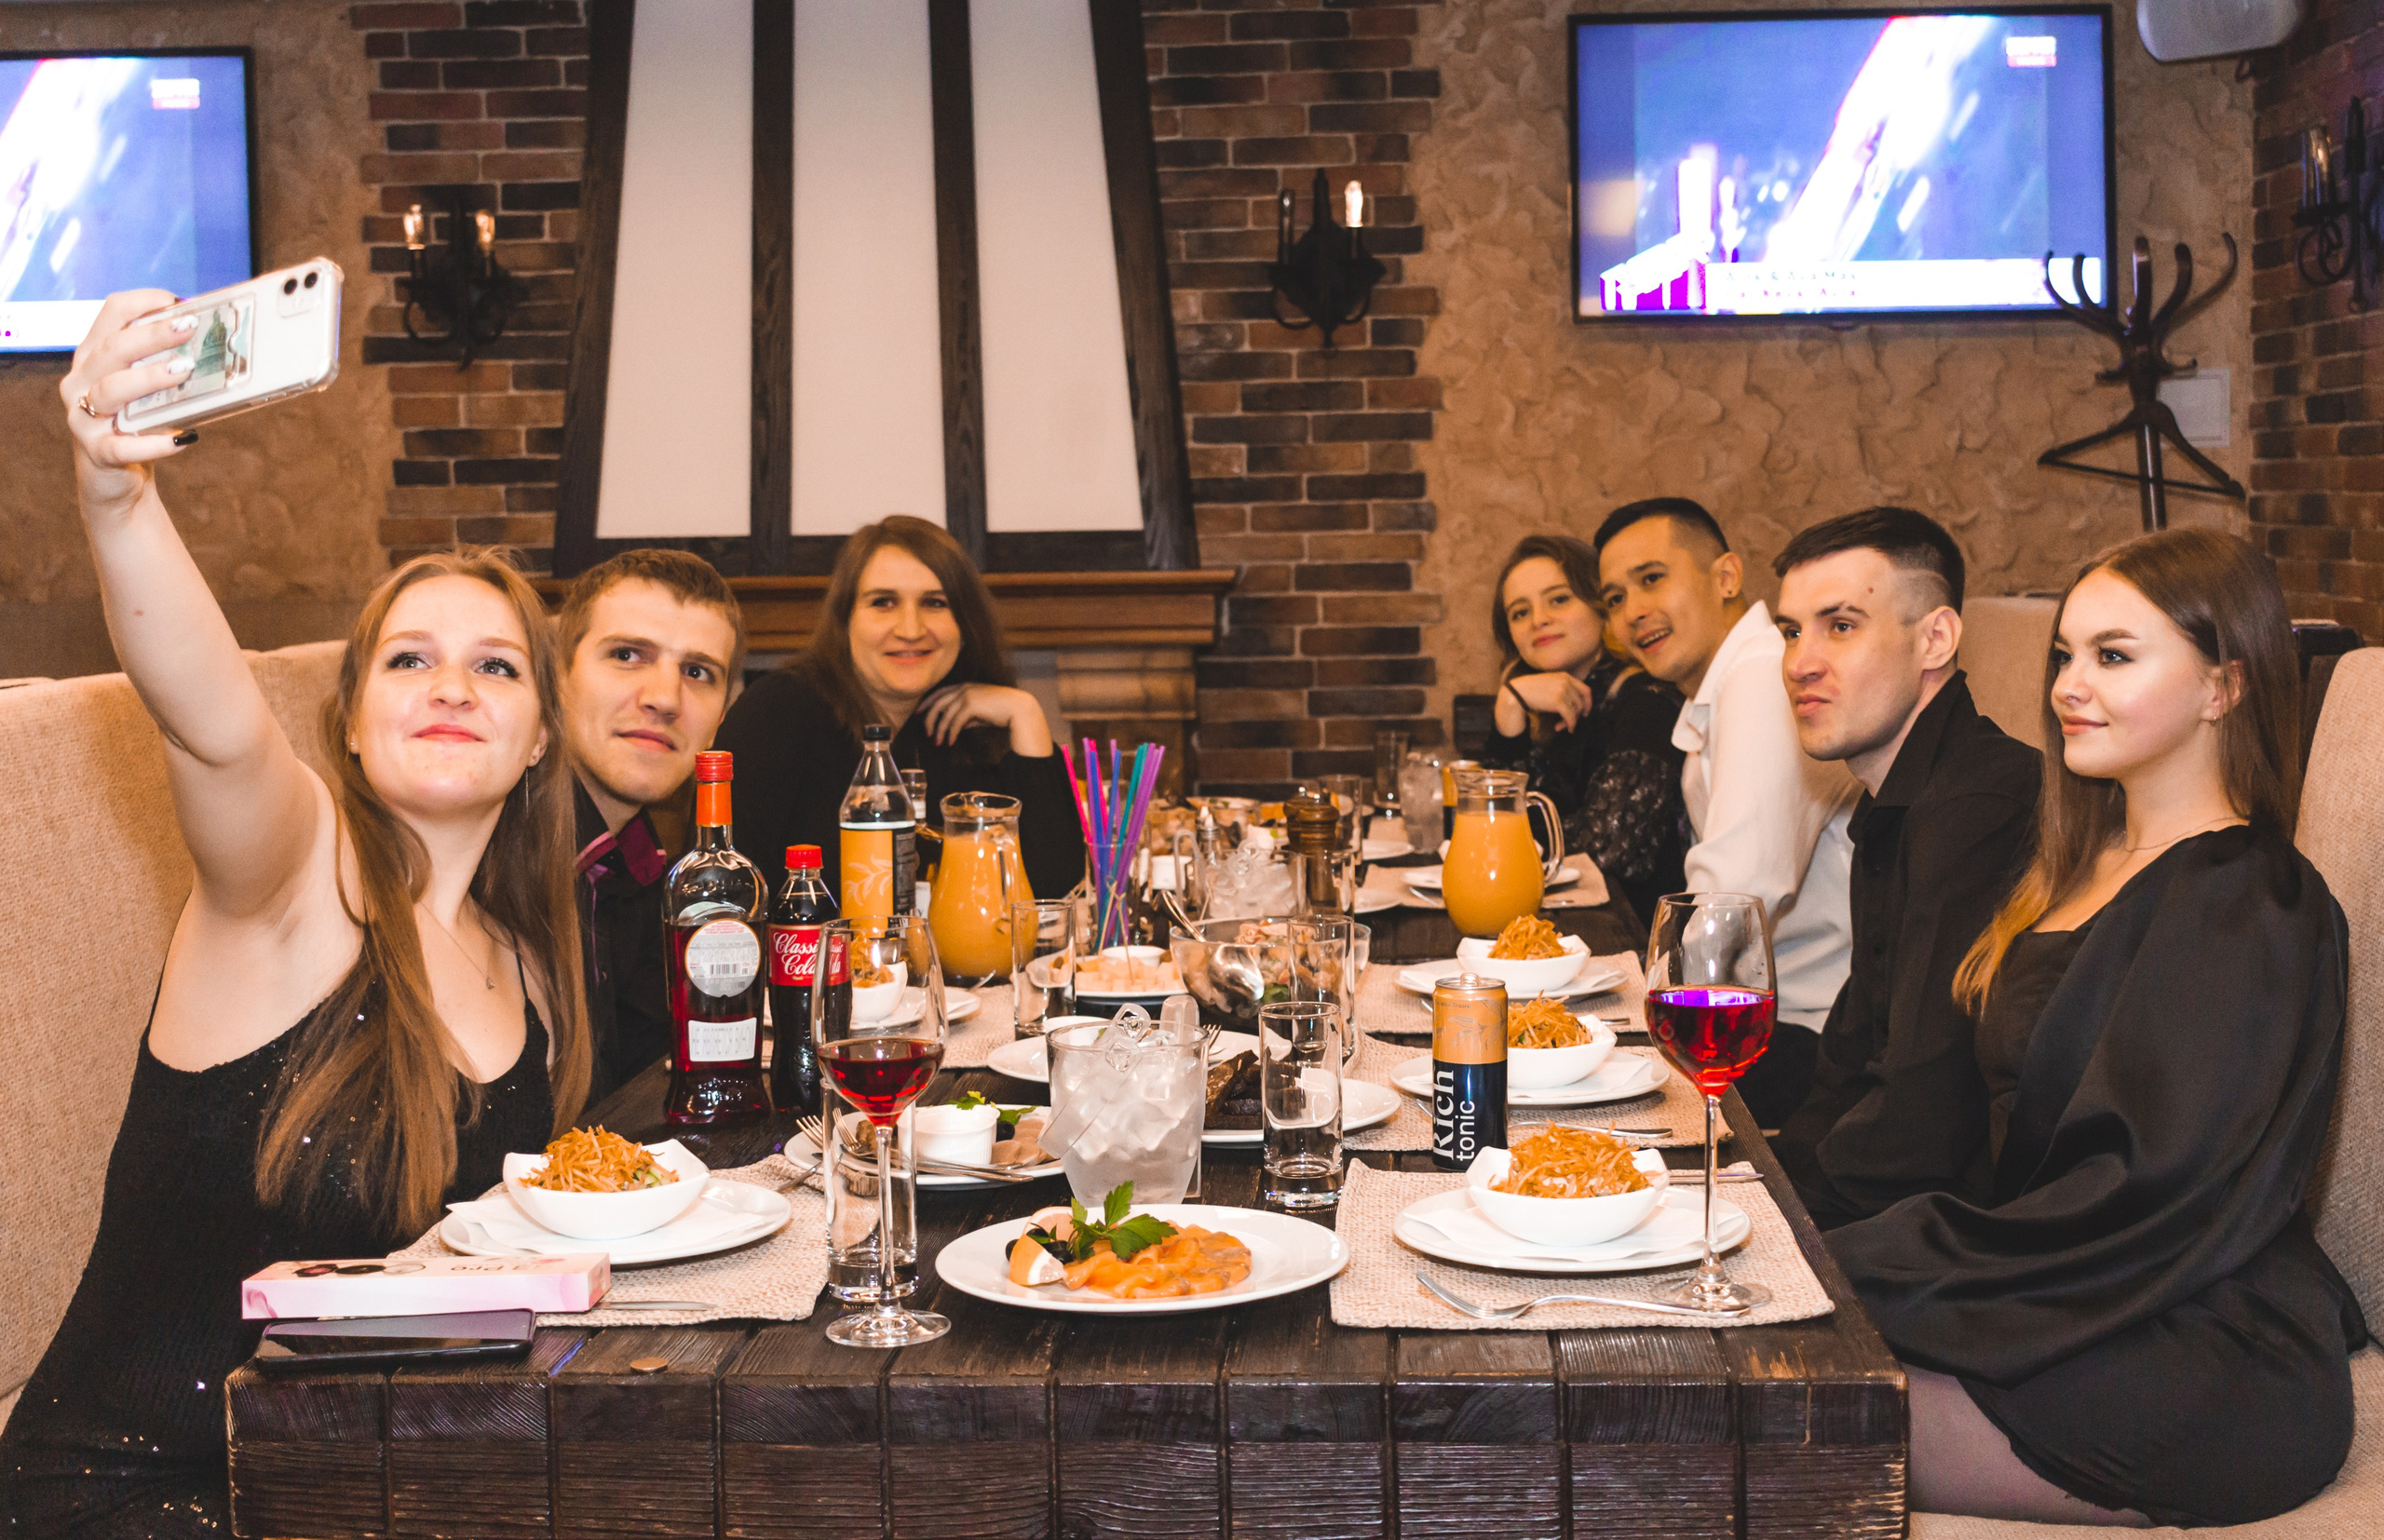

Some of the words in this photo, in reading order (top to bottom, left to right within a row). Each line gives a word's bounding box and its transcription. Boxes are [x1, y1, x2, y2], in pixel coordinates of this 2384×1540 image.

[773, 932, 820, 955] Classi
[1432, 1070, 1455, 1161] Rich
[1456, 1100, 1475, 1162] tonic
